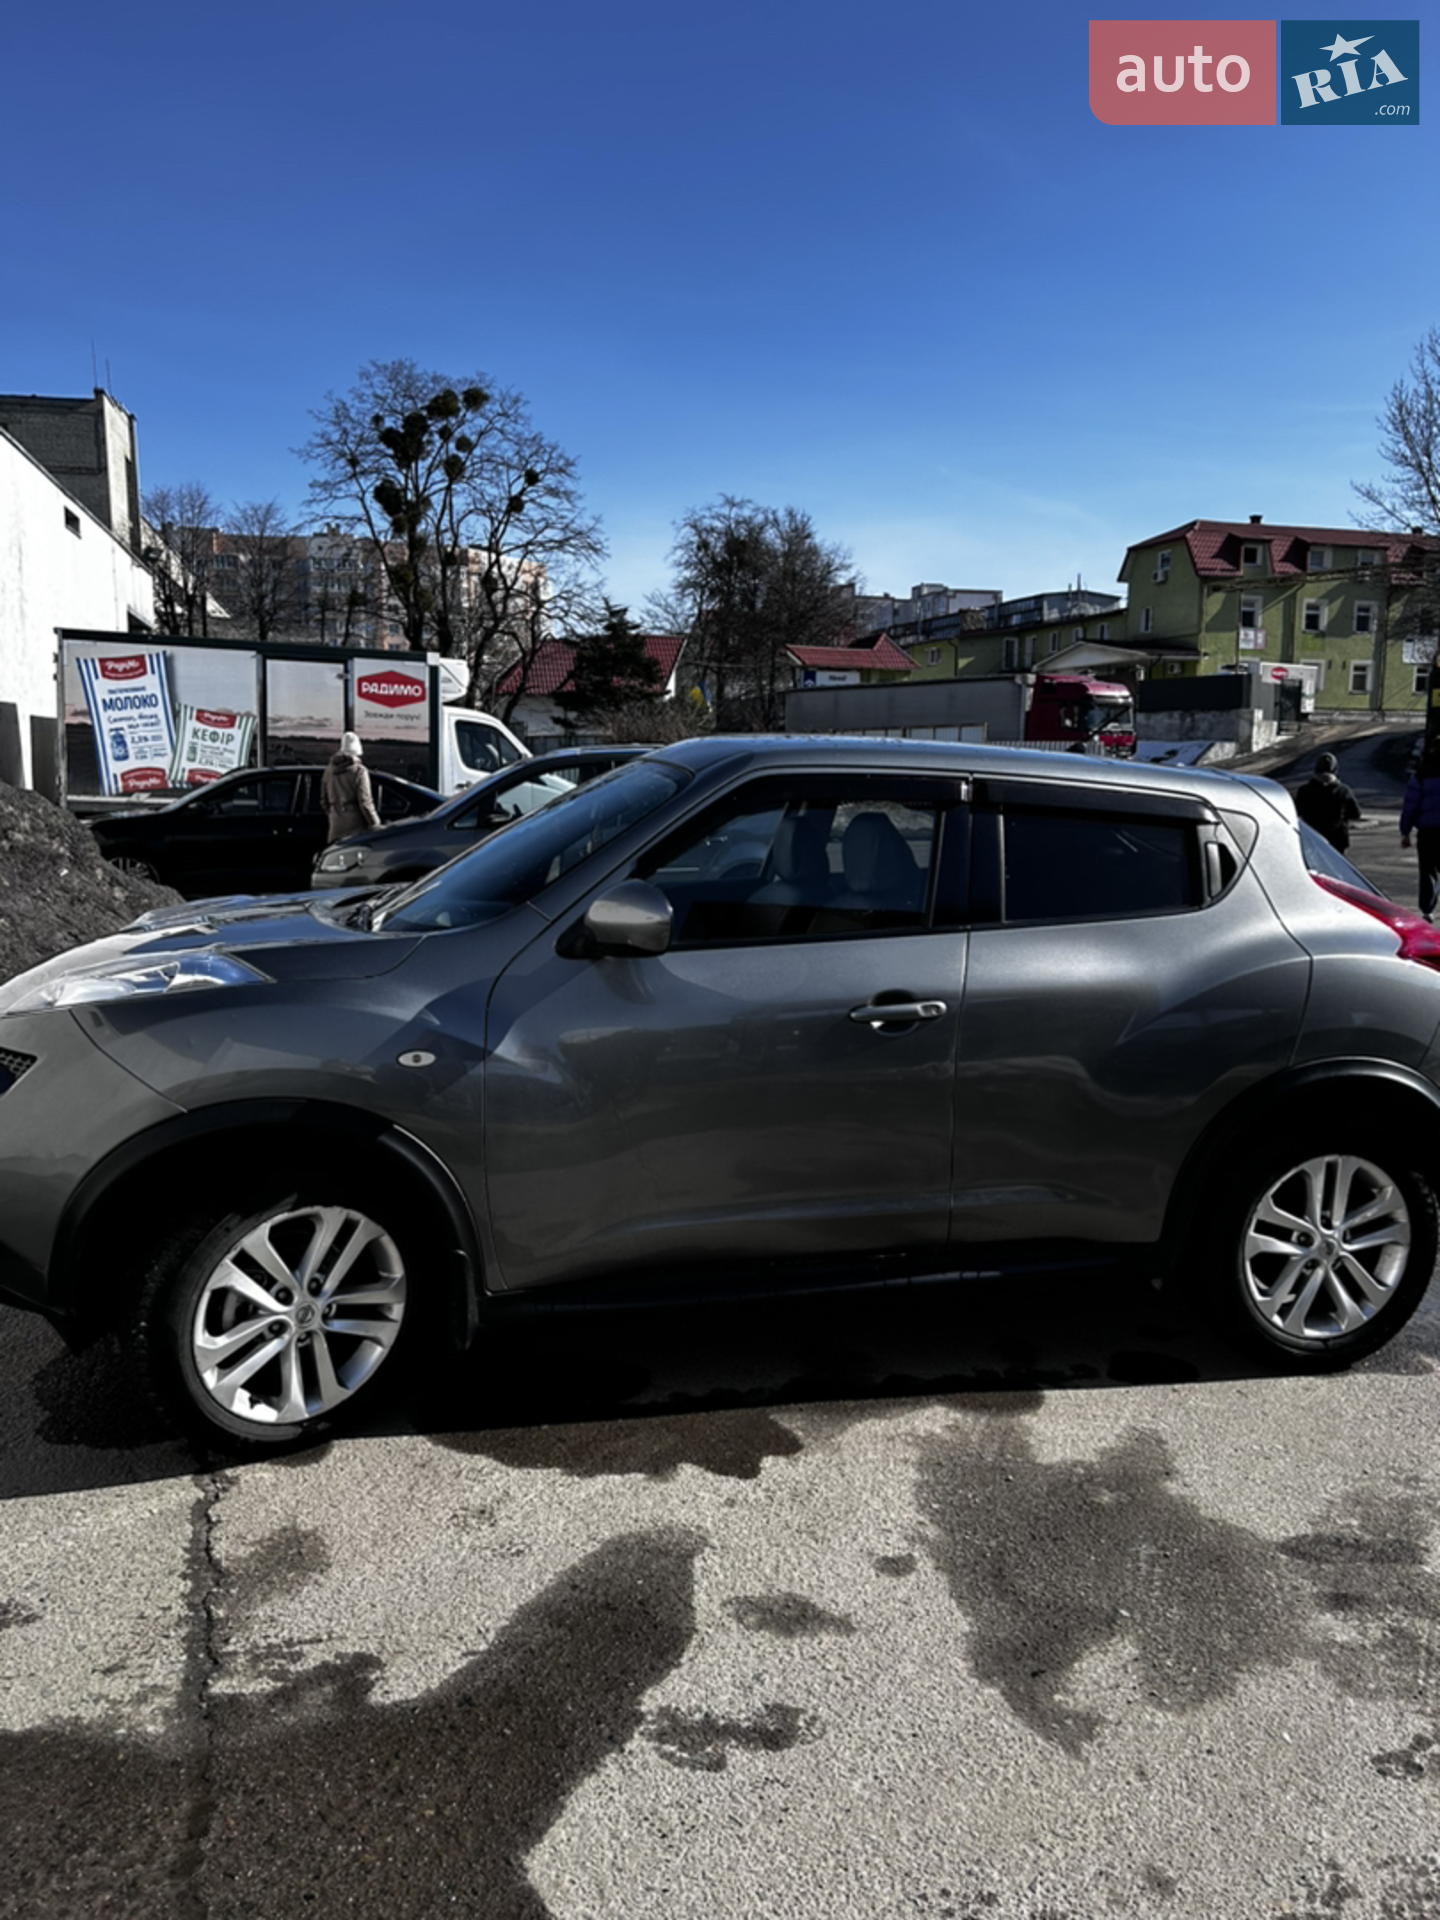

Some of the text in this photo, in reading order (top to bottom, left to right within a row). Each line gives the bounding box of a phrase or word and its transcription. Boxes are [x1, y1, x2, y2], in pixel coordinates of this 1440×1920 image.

[361, 682, 423, 697] РАДИМО
[102, 693, 159, 712] МОЛОКО
[191, 727, 235, 746] КЕФІР
